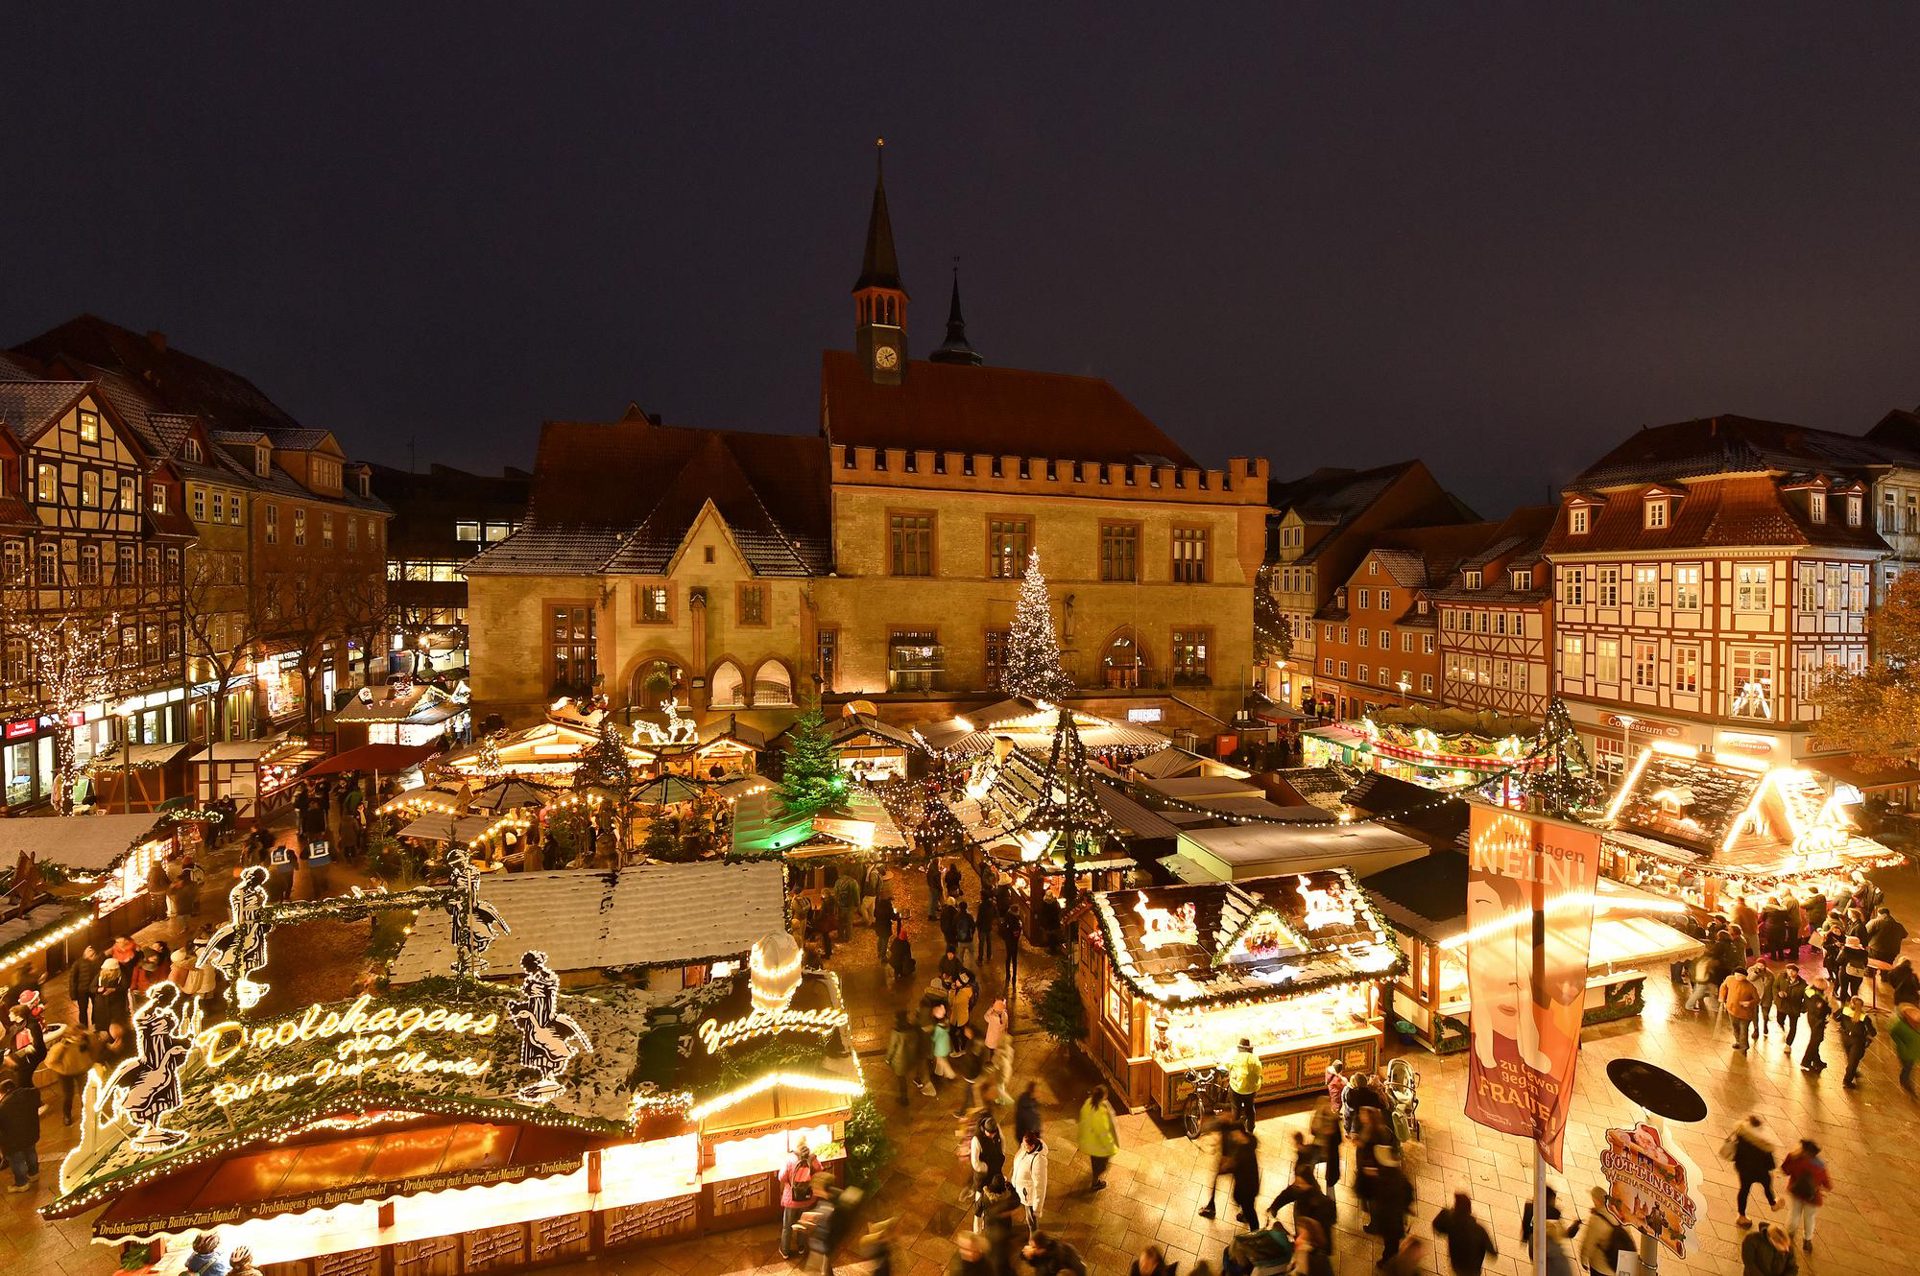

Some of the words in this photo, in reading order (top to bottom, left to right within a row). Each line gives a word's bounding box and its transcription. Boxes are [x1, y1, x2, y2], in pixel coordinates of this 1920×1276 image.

[1535, 842, 1585, 863] sagen
[1471, 844, 1586, 892] NEIN!
[193, 993, 498, 1068] Drolshagens
[1500, 1059, 1518, 1073] zu
[540, 1159, 581, 1174] Drolshagens
[403, 1178, 446, 1192] Drolshagens
[446, 1177, 462, 1187] gute
[259, 1200, 306, 1216] Drolshagens
[307, 1197, 323, 1209] gute
[99, 1221, 148, 1236] Drolshagens
[149, 1219, 167, 1233] gute
